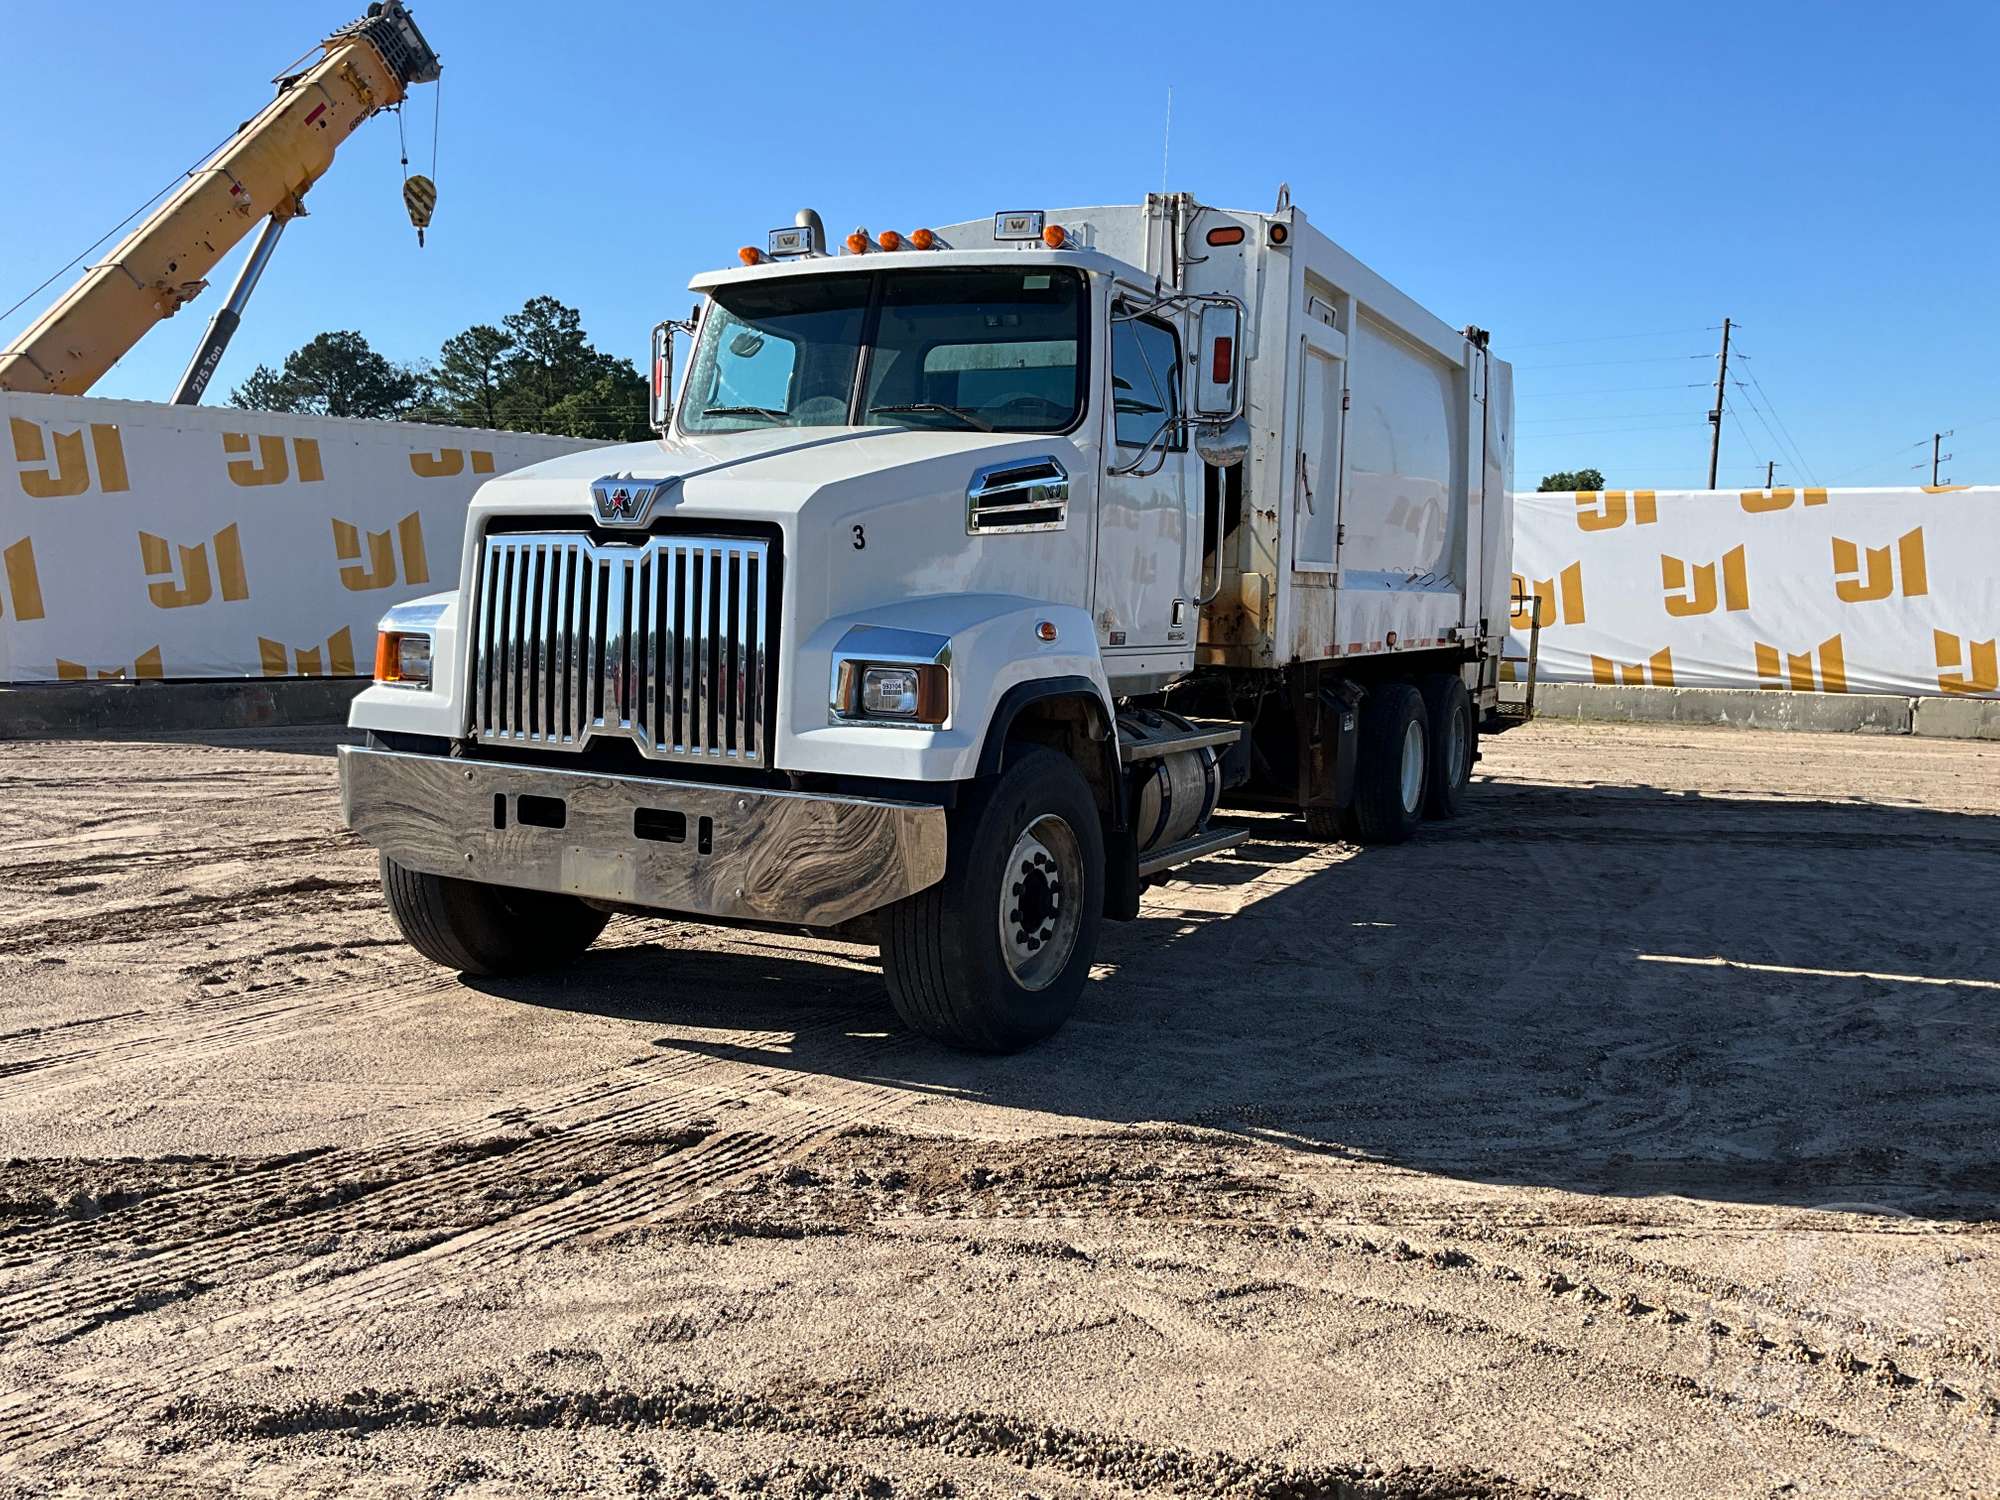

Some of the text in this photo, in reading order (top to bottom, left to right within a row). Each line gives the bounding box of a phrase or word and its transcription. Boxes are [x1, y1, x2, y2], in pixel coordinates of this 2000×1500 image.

[192, 345, 222, 394] 275 Ton
[853, 525, 866, 550] 3
